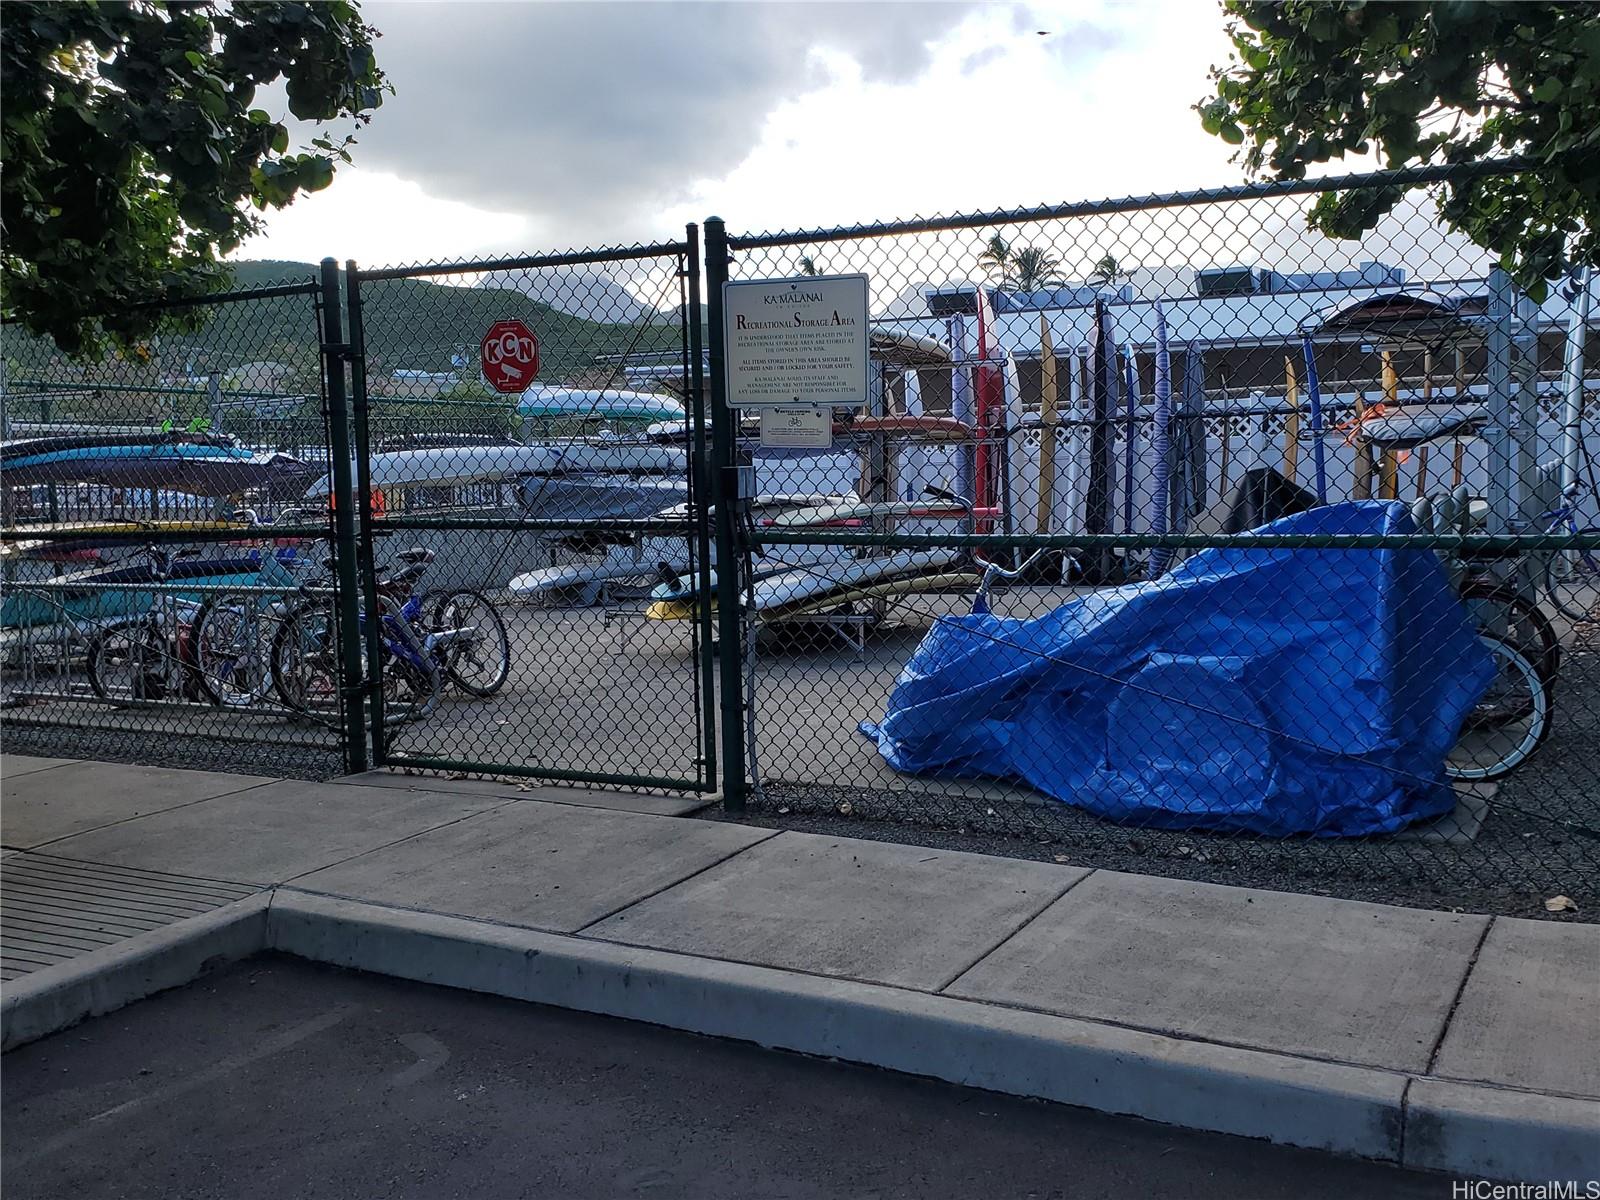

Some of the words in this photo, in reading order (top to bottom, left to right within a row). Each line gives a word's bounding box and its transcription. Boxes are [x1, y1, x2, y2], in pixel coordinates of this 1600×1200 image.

[764, 295, 778, 304] KA
[780, 292, 824, 304] MALANAI
[830, 310, 855, 326] AREA
[488, 334, 532, 361] KCN
